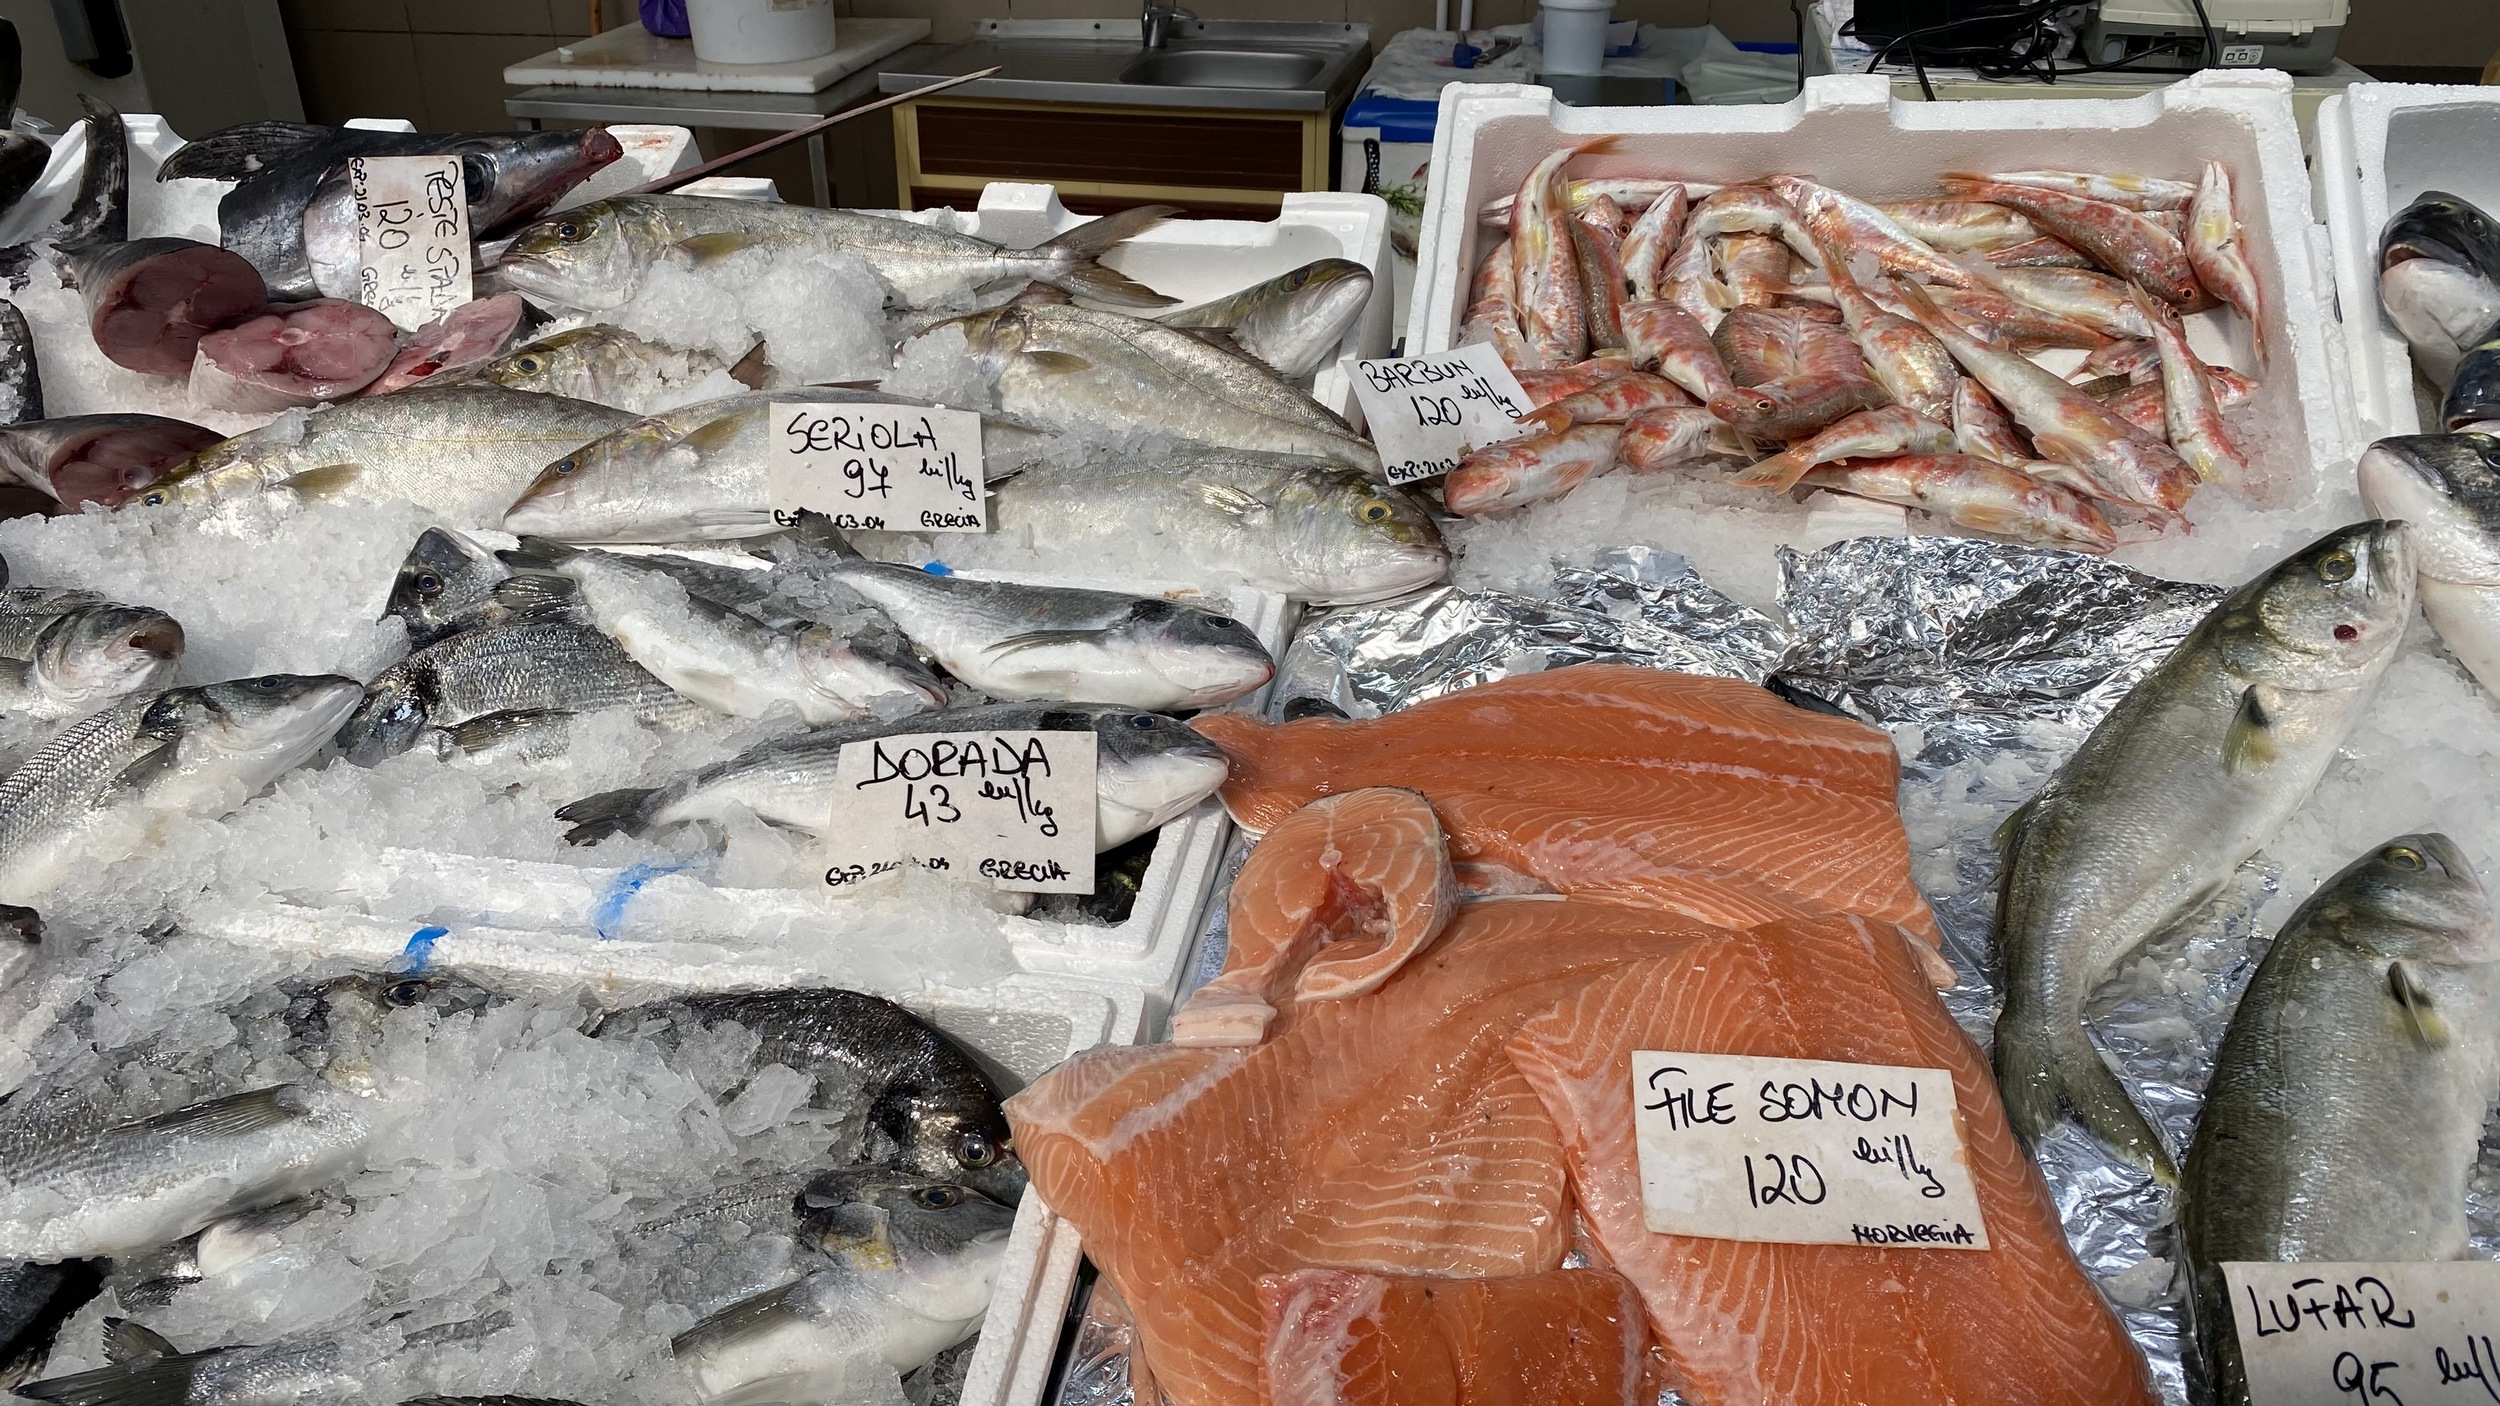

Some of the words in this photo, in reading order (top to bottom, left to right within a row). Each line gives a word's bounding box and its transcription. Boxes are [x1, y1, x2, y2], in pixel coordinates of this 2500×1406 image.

[372, 200, 413, 249] 120
[1359, 359, 1475, 393] BARBUN
[1410, 396, 1462, 427] 120
[843, 457, 893, 499] 97
[856, 736, 1052, 791] DORADA
[904, 783, 961, 827] 43
[1644, 1067, 1737, 1131] FILE
[1759, 1077, 1918, 1123] SOMON
[1743, 1154, 1827, 1209] 120
[2246, 1276, 2416, 1338] LUFAR
